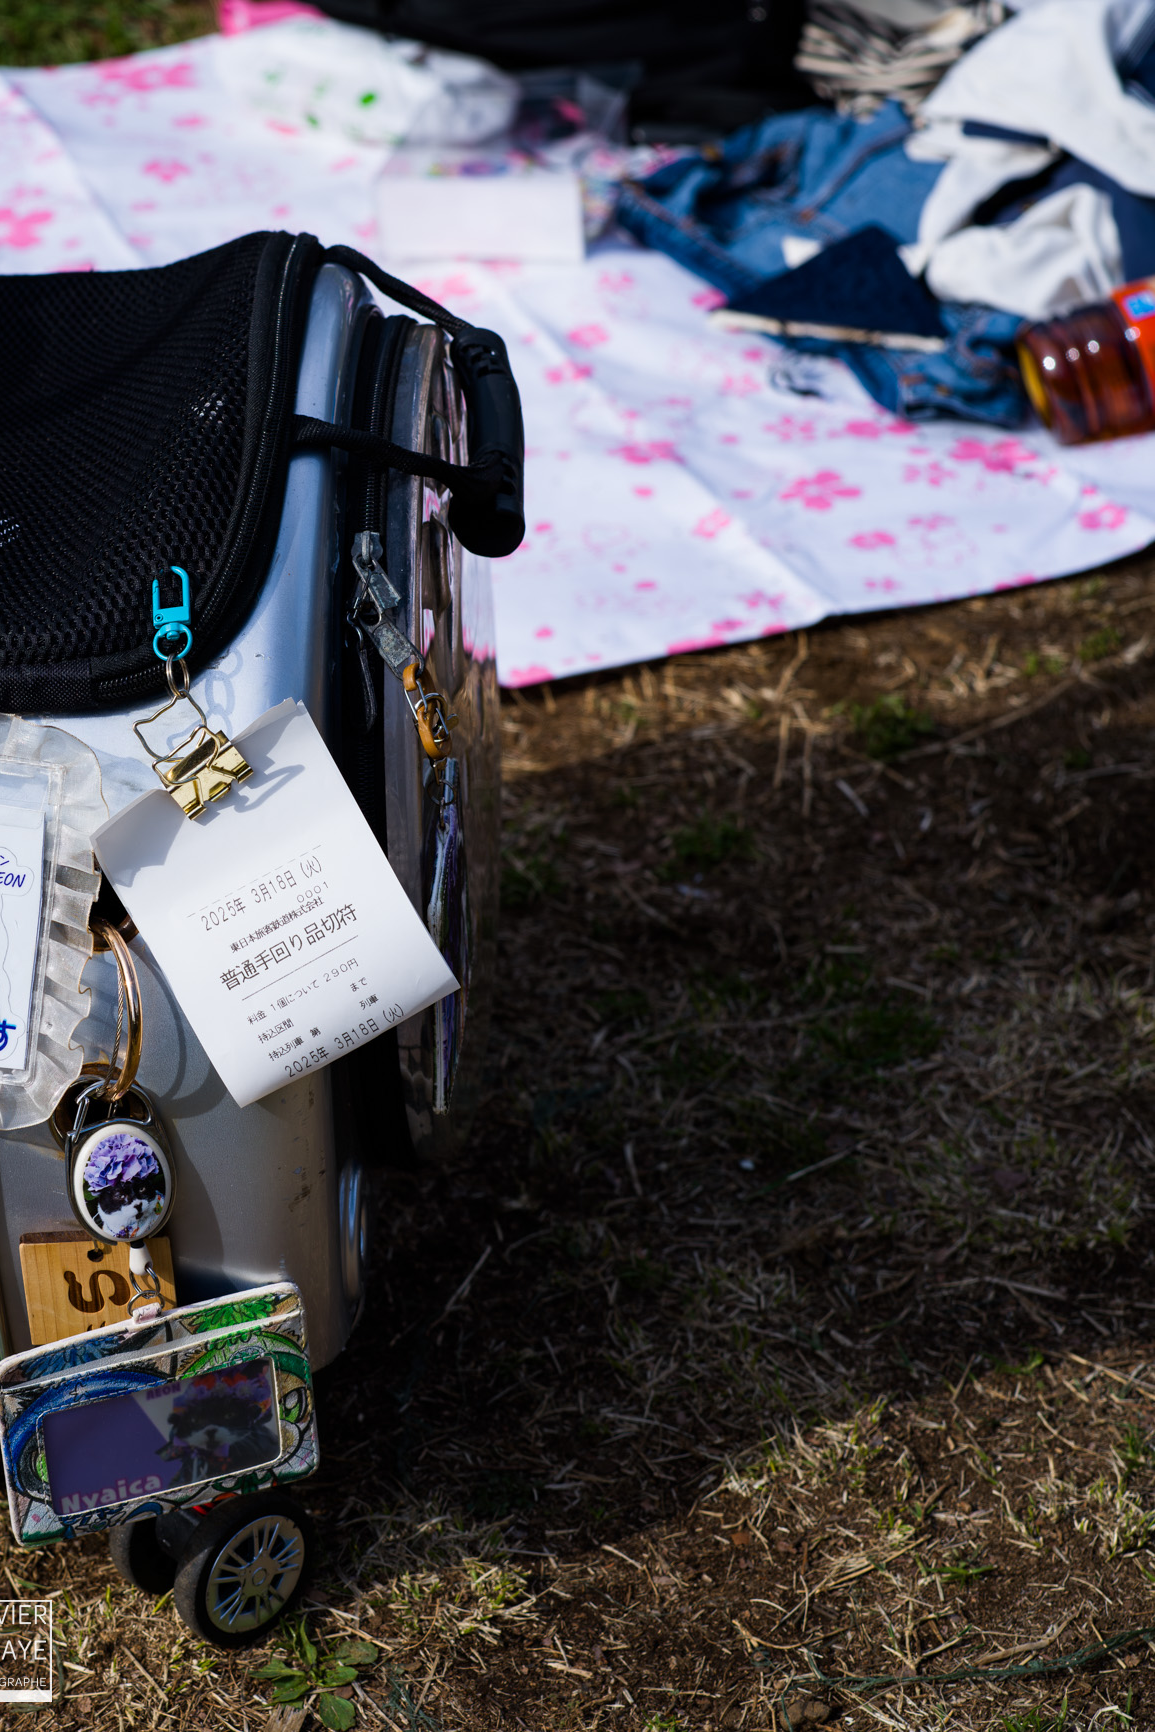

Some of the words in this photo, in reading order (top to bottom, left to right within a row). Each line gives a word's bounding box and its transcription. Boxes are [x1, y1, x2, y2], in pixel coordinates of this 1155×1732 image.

[201, 897, 247, 931] 2025年
[251, 870, 297, 904] 3月18日
[296, 881, 329, 903] 0001
[219, 903, 359, 991] 普通手回り品切符
[257, 1017, 294, 1044] 持込区間
[349, 976, 369, 993] まで
[358, 993, 379, 1011] 列車
[284, 1045, 330, 1078] 2025年
[333, 1018, 380, 1050] 3月18日
[146, 1382, 182, 1401] AEON
[60, 1475, 162, 1514] Nyaica
